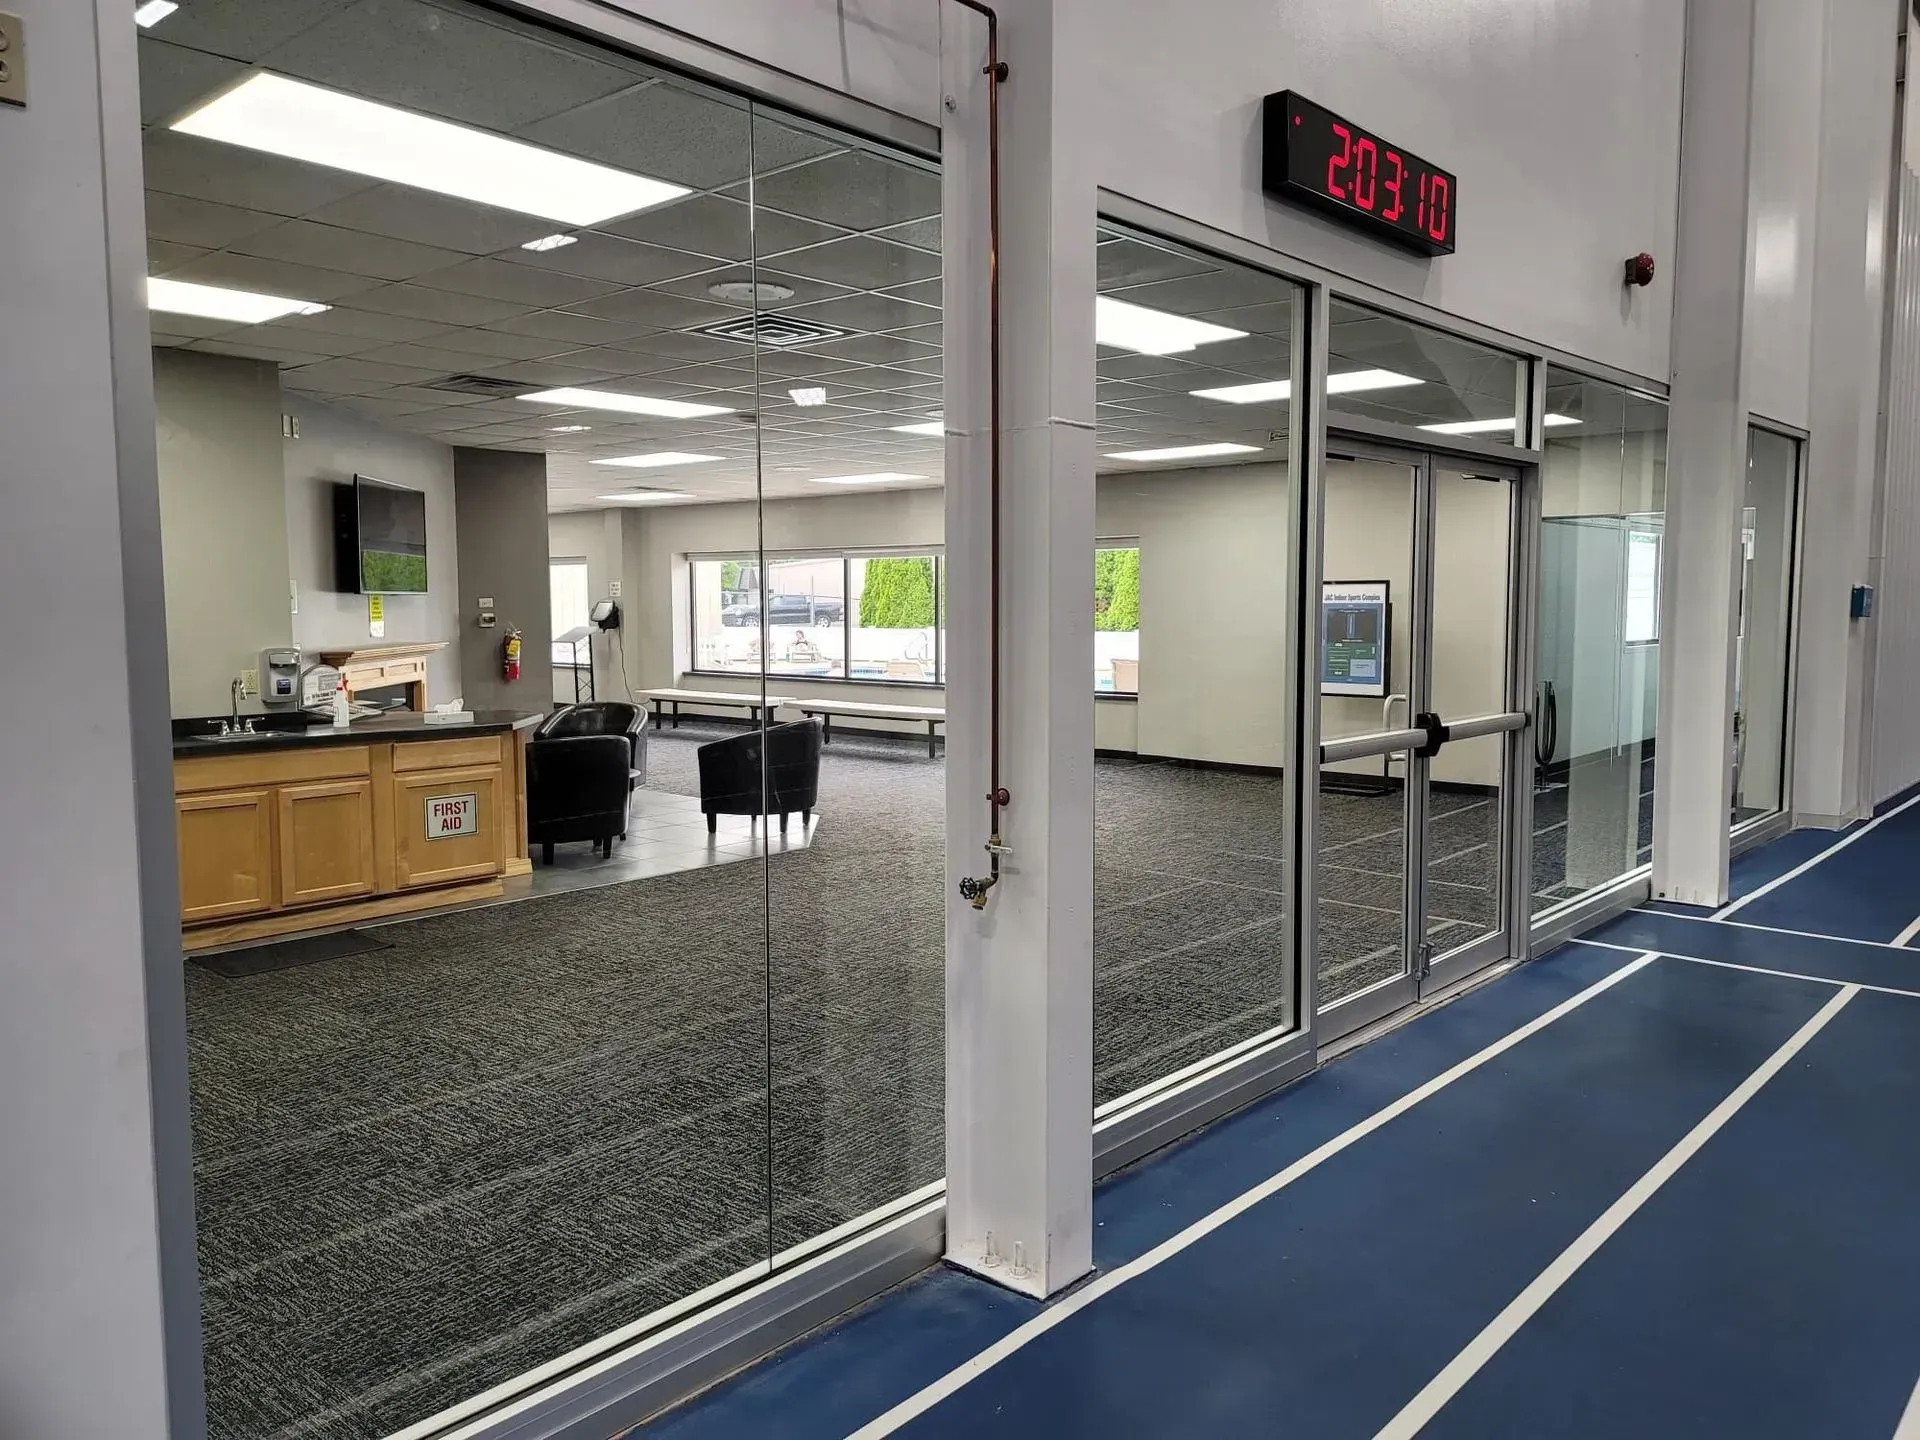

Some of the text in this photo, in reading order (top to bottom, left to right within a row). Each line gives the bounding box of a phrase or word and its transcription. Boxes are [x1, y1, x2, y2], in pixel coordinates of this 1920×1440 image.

[1328, 123, 1448, 240] 2:03:10
[1348, 593, 1361, 602] Sports
[1362, 593, 1380, 602] Complex
[434, 801, 468, 816] FIRST
[442, 817, 461, 831] AID
